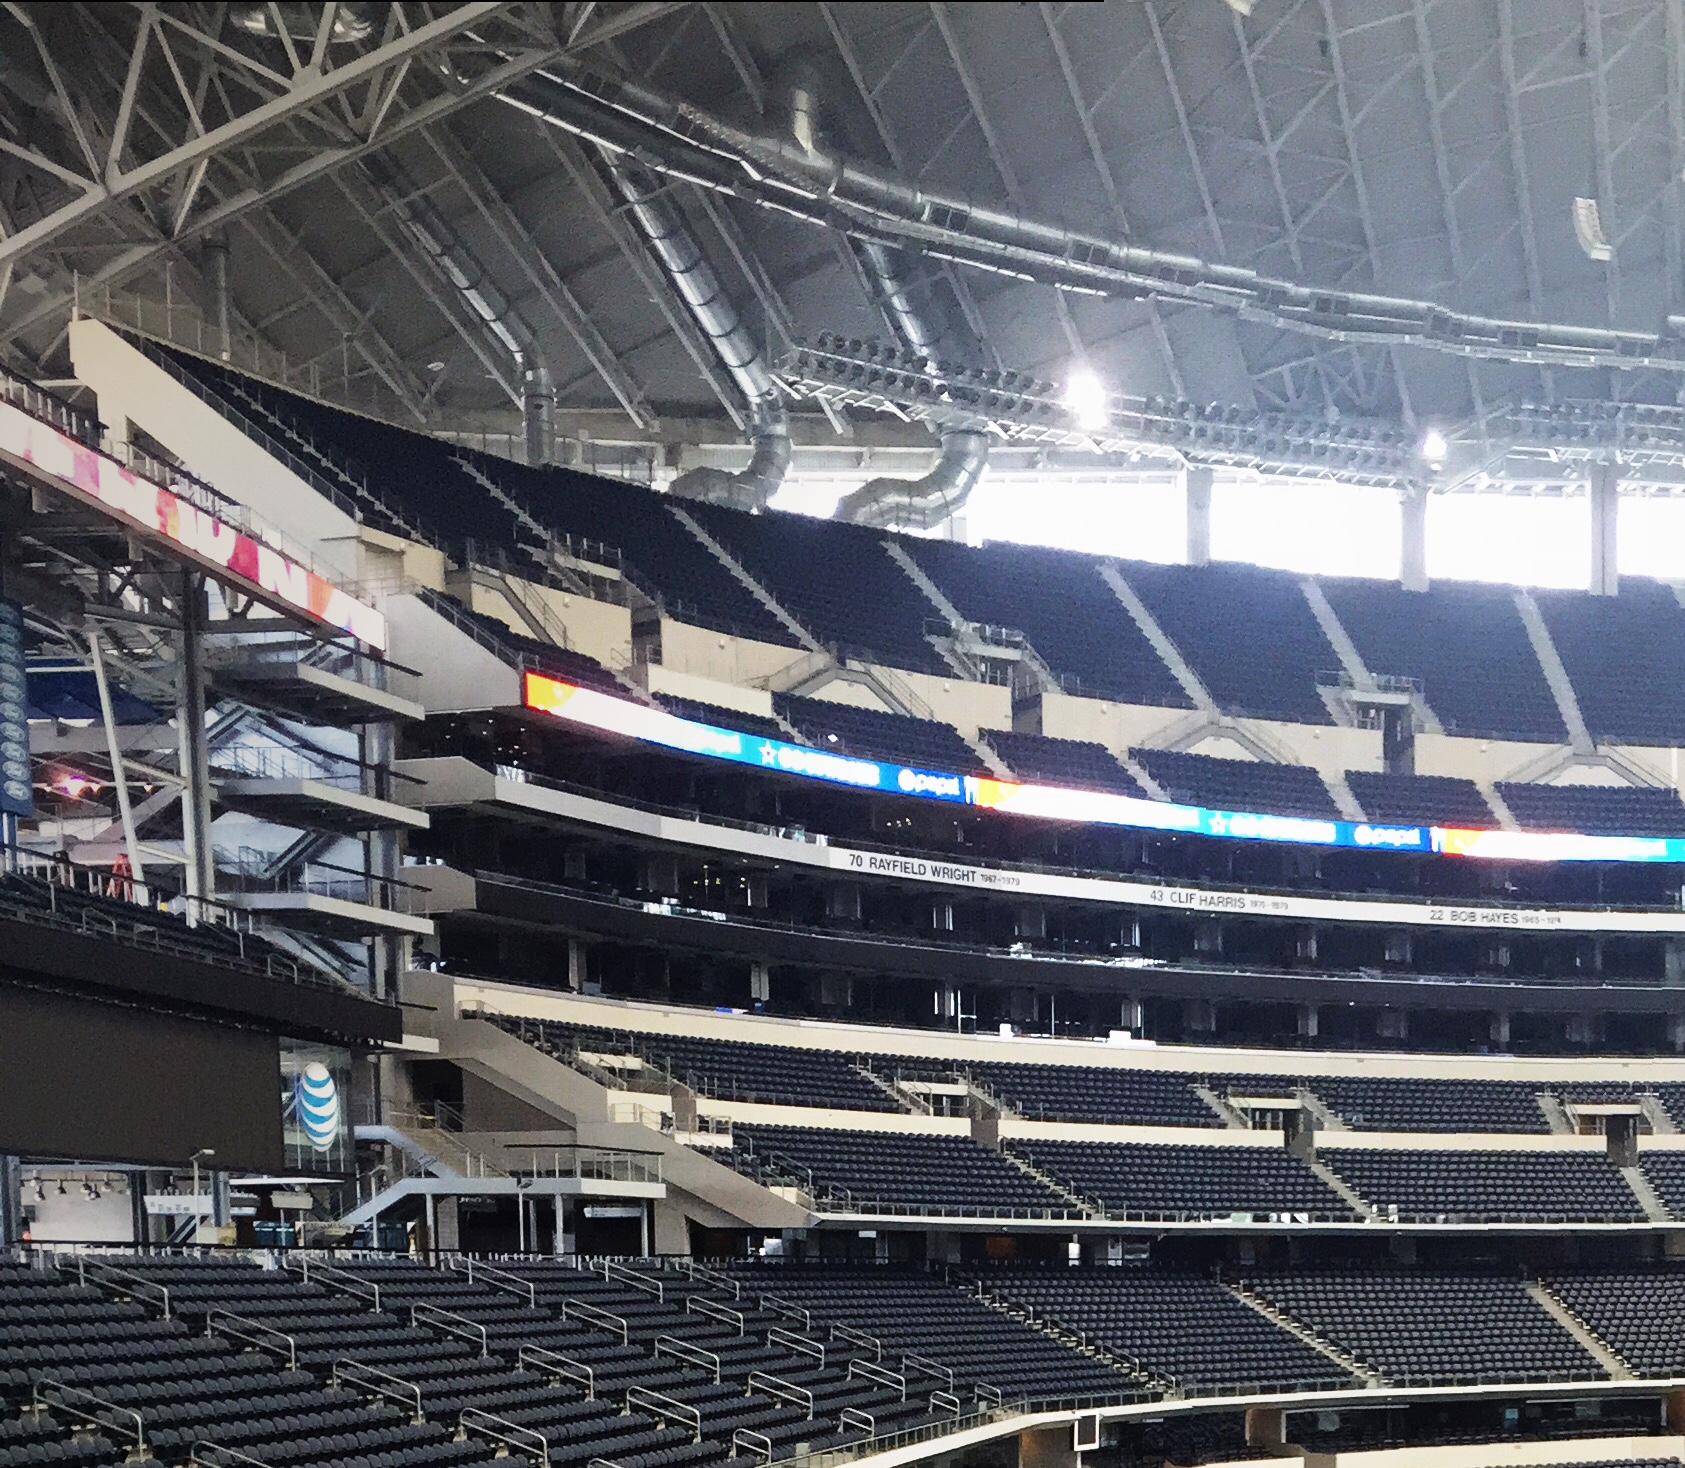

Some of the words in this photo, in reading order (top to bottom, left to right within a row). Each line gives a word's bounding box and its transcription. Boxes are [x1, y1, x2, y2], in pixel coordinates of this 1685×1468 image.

[849, 853, 863, 867] 70
[869, 857, 926, 876] RAYFIELD
[931, 866, 978, 883] WRIGHT
[1150, 890, 1164, 902] 43
[1200, 895, 1246, 909] HARRIS
[1430, 910, 1444, 920] 22
[1450, 911, 1477, 922] BOB
[1480, 912, 1519, 924] HAYES
